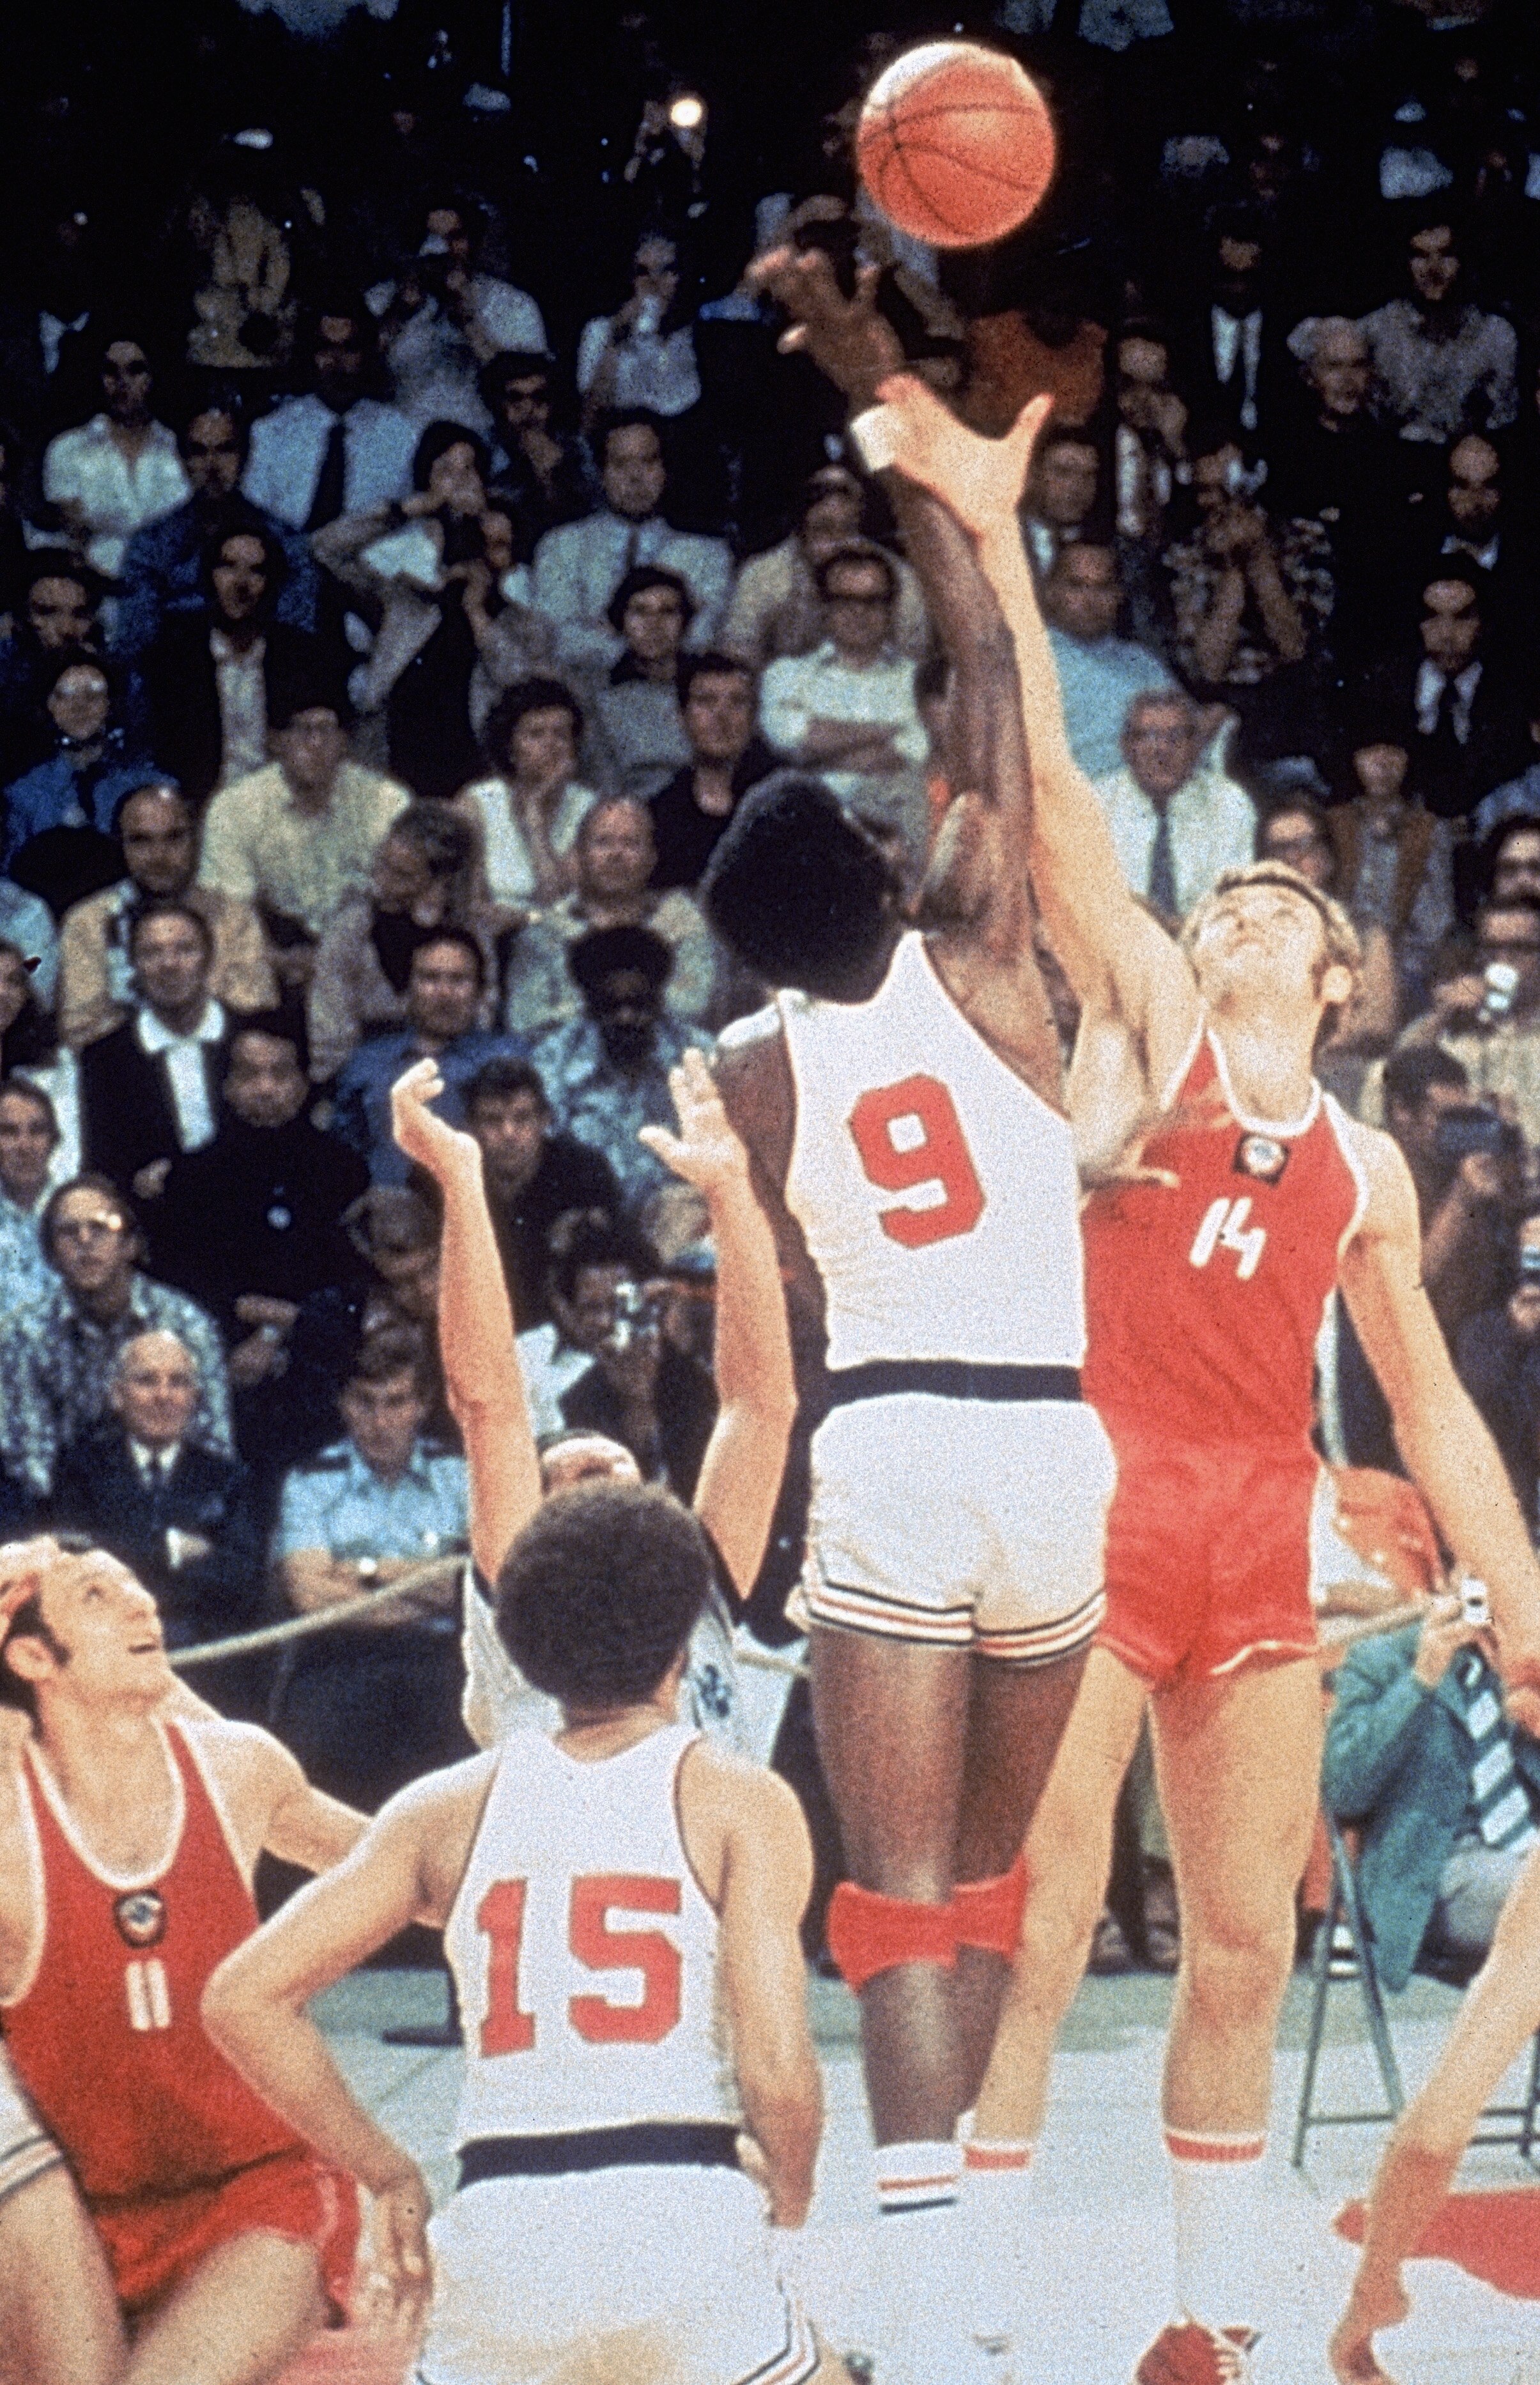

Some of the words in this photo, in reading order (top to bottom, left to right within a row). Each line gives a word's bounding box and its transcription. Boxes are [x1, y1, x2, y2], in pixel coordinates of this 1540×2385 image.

[847, 1074, 986, 1248] 9
[1189, 1196, 1267, 1281] 14
[125, 1958, 171, 2031] 11
[477, 1872, 682, 2058] 15
